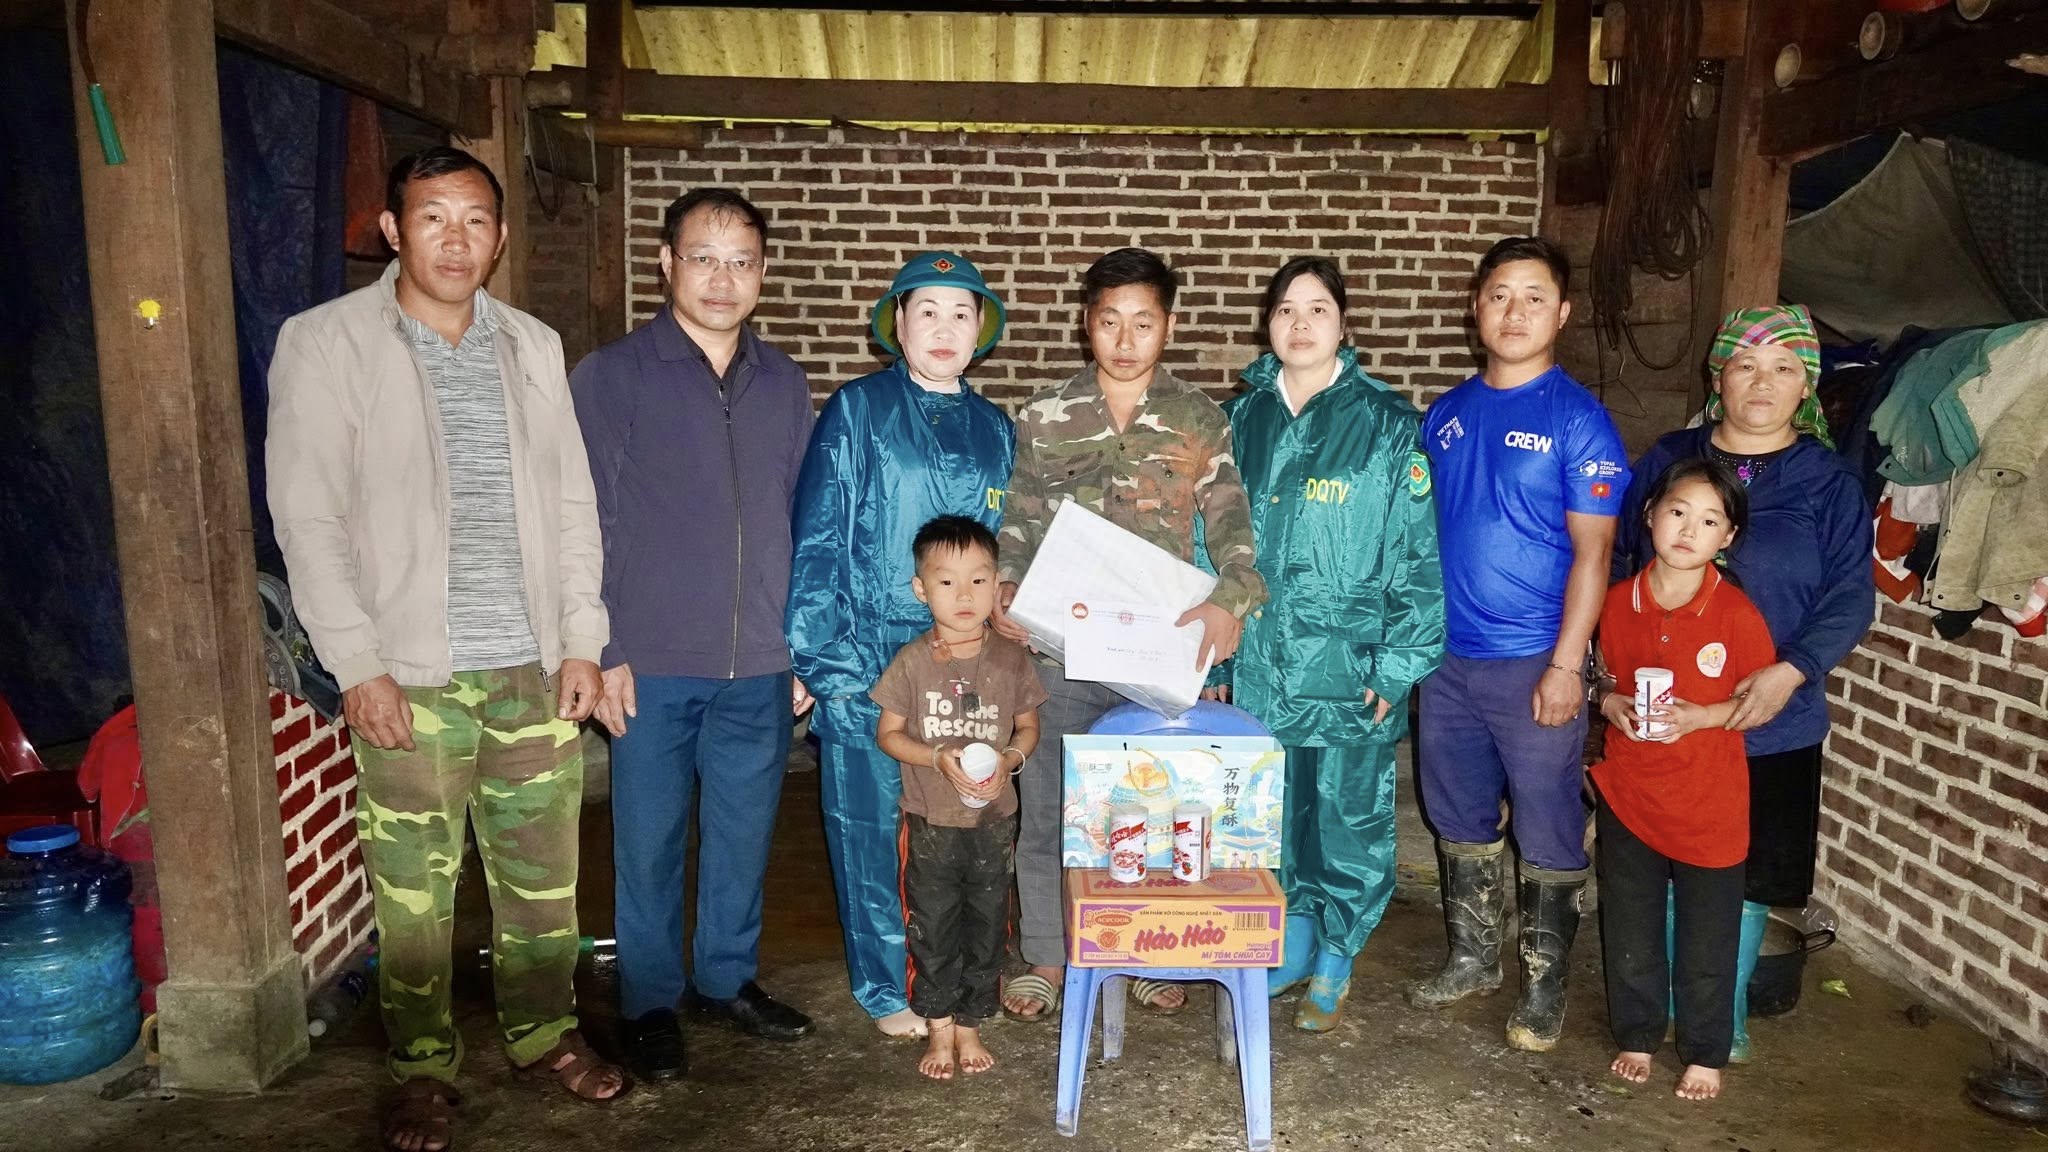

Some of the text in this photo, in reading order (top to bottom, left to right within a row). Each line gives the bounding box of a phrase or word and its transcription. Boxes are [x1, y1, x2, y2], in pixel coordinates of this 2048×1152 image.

[1504, 430, 1552, 454] CREW
[1306, 477, 1349, 504] DQTV
[925, 691, 953, 715] To
[923, 716, 999, 741] Rescue
[1134, 924, 1179, 952] Hảo
[1181, 919, 1226, 948] Hảo
